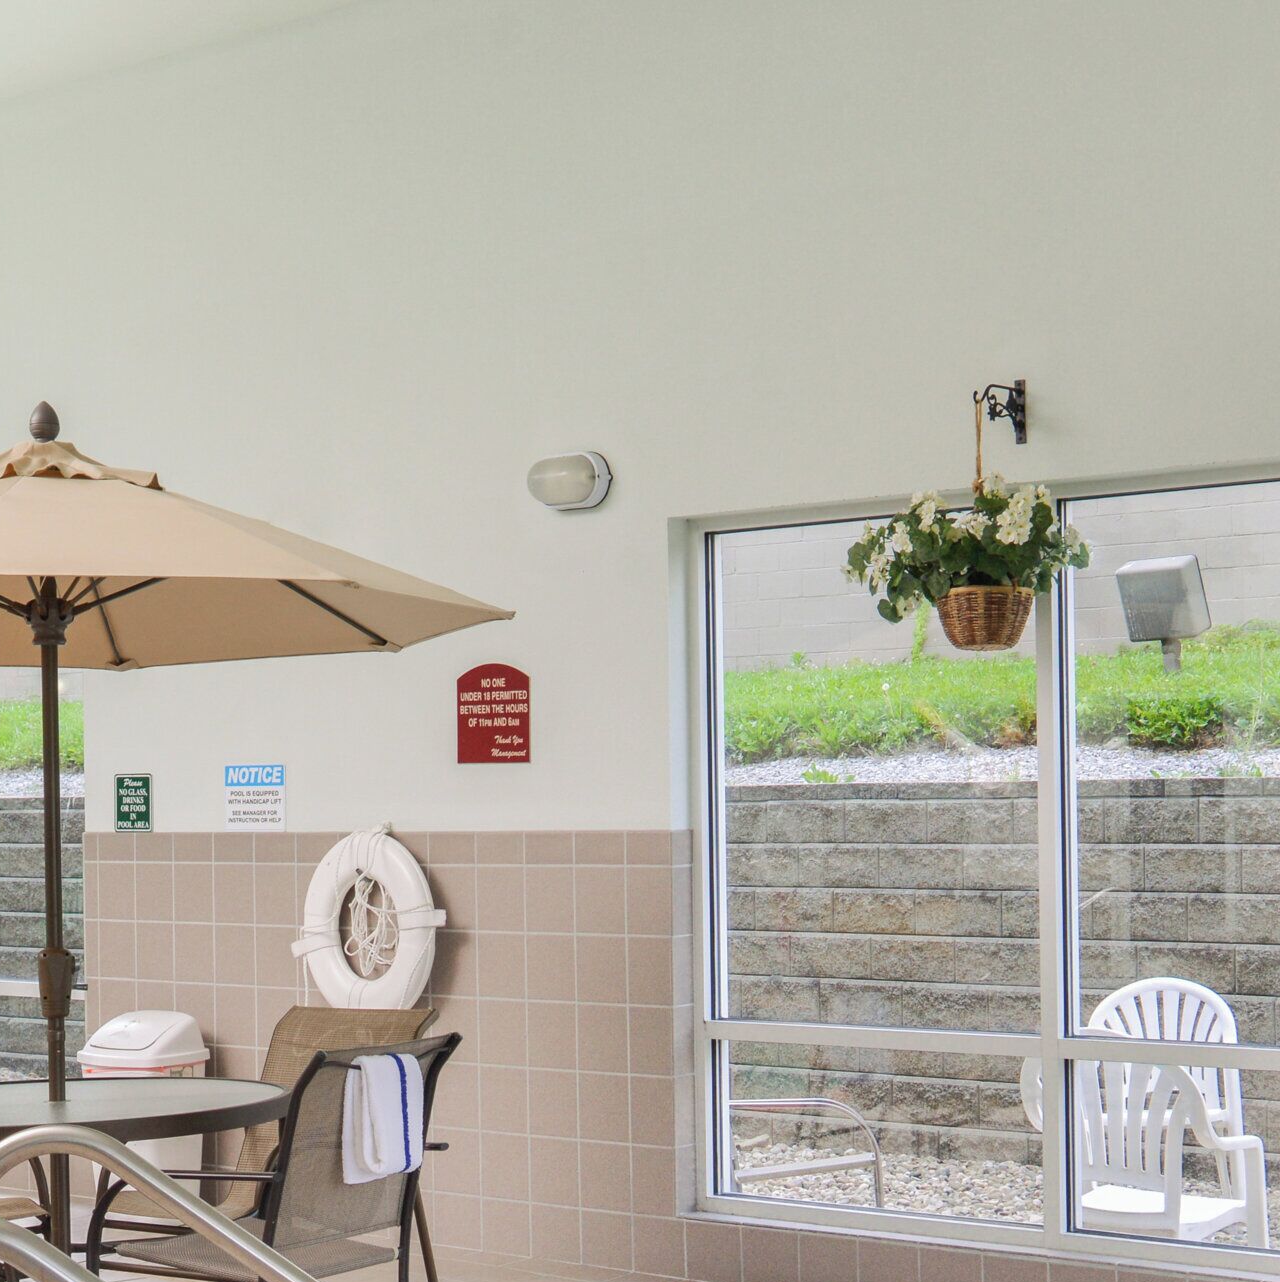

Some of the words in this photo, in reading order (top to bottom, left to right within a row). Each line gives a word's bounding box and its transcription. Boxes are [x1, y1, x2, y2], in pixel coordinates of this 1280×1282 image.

[481, 679, 491, 687] NO
[492, 678, 505, 687] ONE
[460, 692, 482, 701] UNDER
[483, 691, 491, 701] 18
[492, 690, 527, 700] PERMITTED
[460, 705, 490, 714] BETWEEN
[492, 705, 504, 713] THE
[506, 704, 528, 713] HOURS
[468, 718, 477, 727] OF
[479, 718, 492, 727] 11PM
[493, 718, 506, 726] AND
[494, 735, 511, 744] Thank
[512, 735, 523, 745] You
[491, 748, 527, 759] Management
[228, 767, 282, 784] NOTICE
[124, 779, 143, 787] Please
